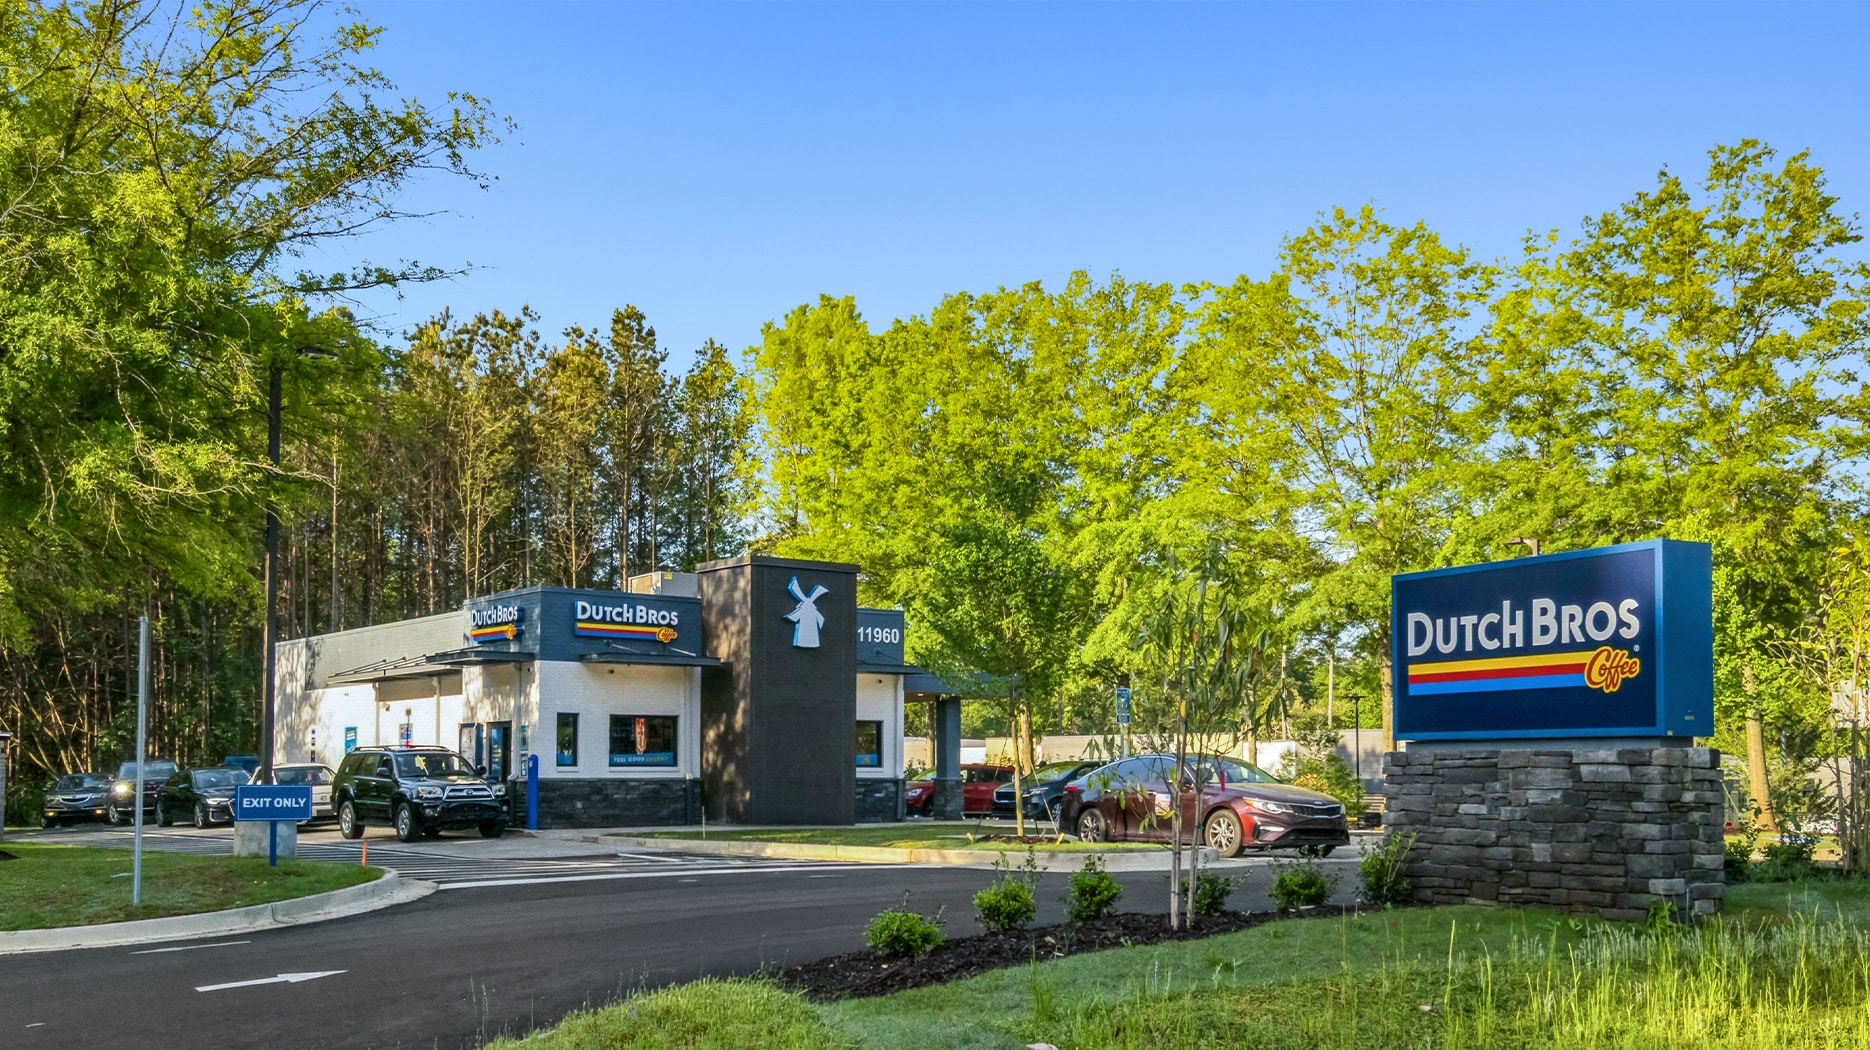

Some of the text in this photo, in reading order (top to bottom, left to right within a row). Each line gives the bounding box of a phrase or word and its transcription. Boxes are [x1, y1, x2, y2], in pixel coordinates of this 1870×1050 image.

[497, 604, 518, 623] BROS
[635, 605, 679, 626] BROS
[1532, 598, 1640, 646] BROS
[857, 626, 900, 644] 11960
[1586, 647, 1639, 692] Coffee
[242, 797, 307, 808] EXIT ONLY
